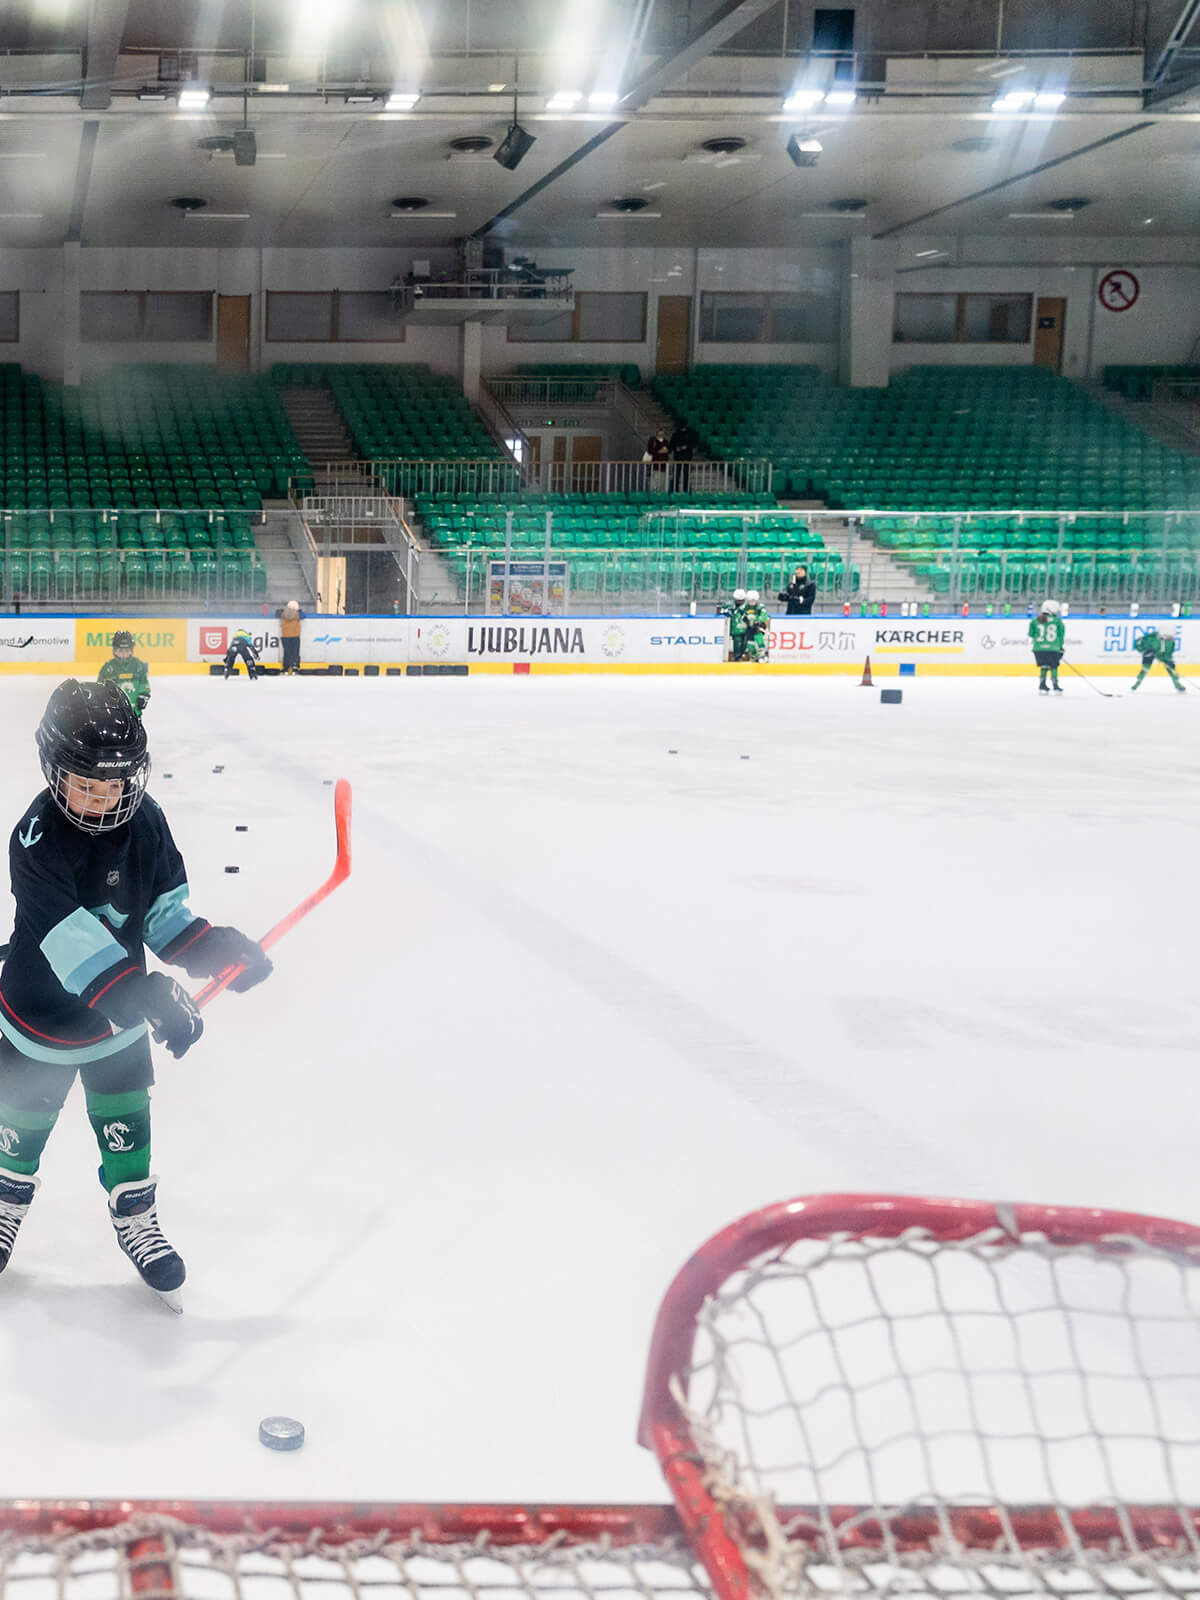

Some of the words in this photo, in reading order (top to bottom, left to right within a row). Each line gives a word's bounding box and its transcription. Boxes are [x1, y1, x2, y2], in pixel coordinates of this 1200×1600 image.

[87, 631, 175, 648] MEKUR
[467, 626, 585, 656] LJUBLJANA
[650, 636, 724, 645] STADLE
[818, 631, 856, 651] 贝尔
[875, 629, 964, 643] KÄRCHER
[1036, 623, 1058, 642] 18
